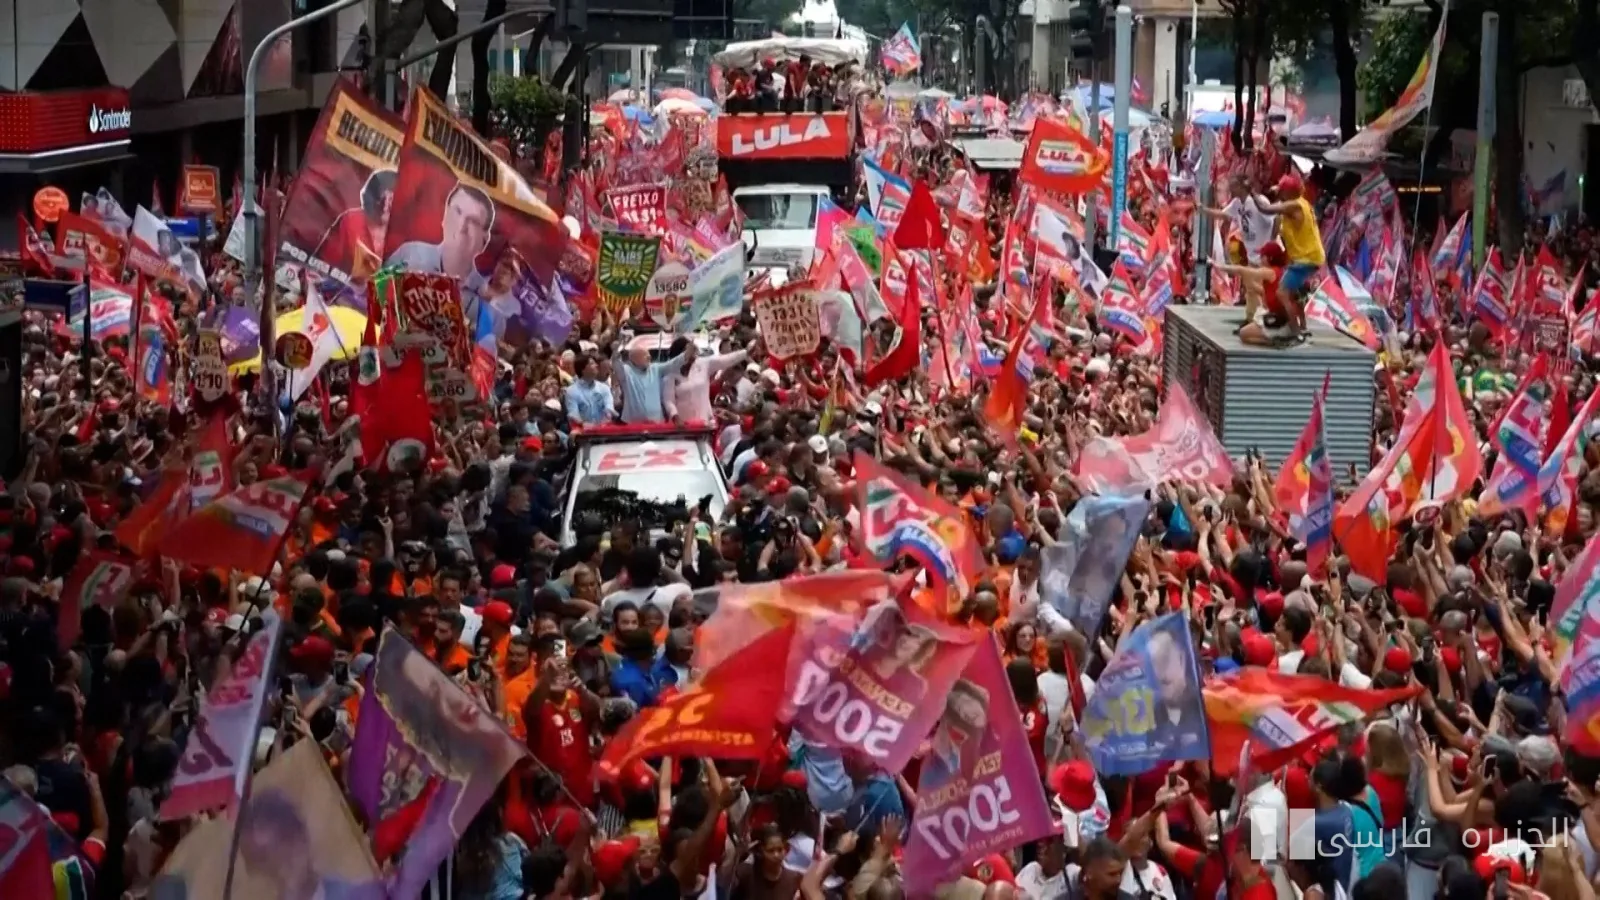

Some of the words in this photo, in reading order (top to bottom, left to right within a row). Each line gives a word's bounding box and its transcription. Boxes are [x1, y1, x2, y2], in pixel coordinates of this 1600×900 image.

[99, 108, 131, 131] Santander
[732, 117, 832, 155] LULA
[1038, 149, 1085, 163] LULA
[613, 192, 659, 208] FREIXO
